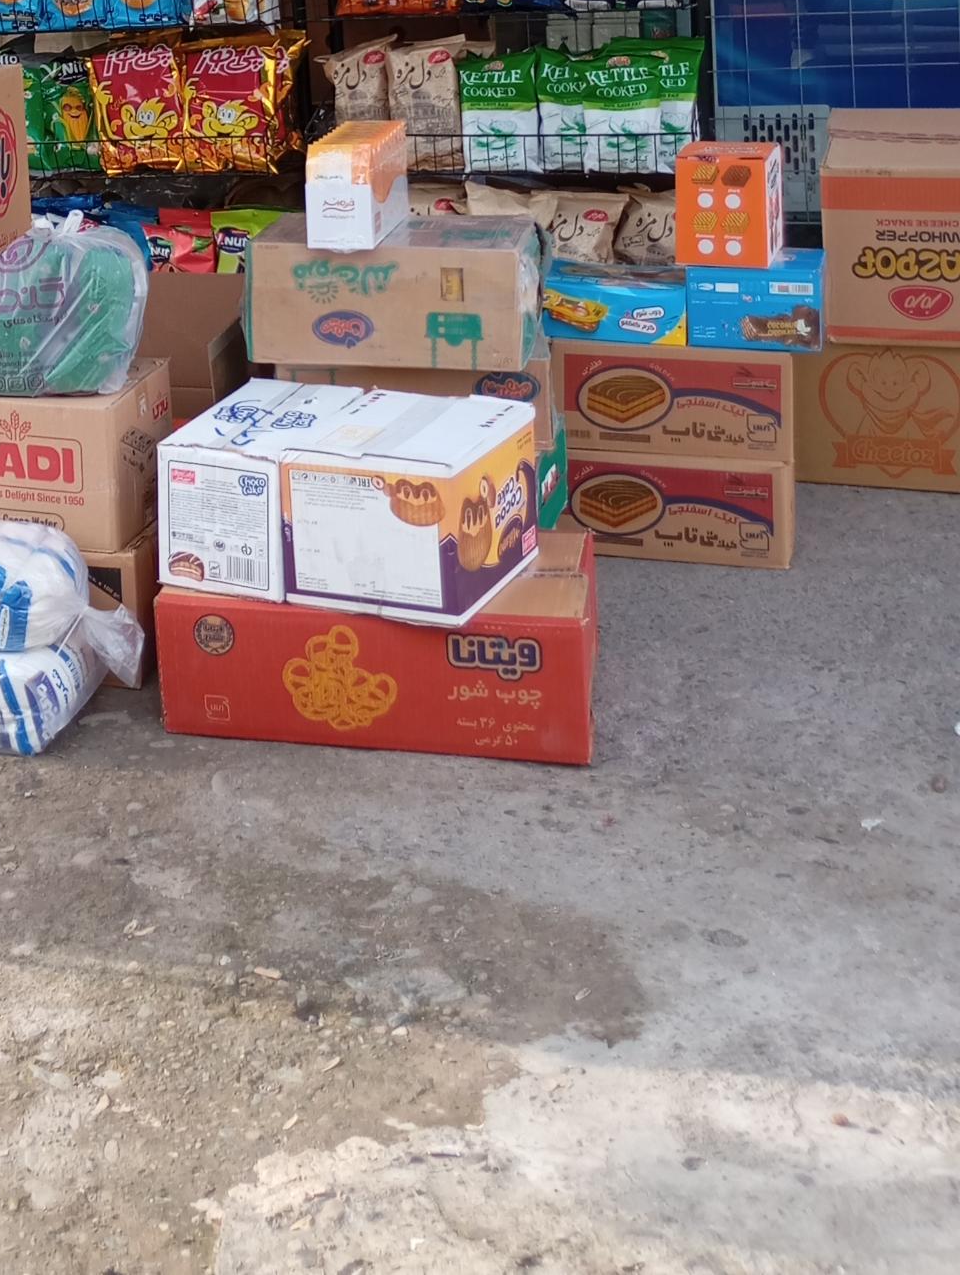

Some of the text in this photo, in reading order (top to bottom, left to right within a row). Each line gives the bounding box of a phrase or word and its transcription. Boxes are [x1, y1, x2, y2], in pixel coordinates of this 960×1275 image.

[459, 69, 523, 85] KETTLE
[585, 67, 652, 85] KETTLE
[463, 86, 516, 99] COOKED
[597, 83, 647, 98] COOKED
[875, 218, 959, 228] CHEESE SNACK
[676, 396, 721, 412] اسفنجی
[852, 438, 935, 464] Cheetoz
[5, 490, 35, 503] Delight
[37, 493, 61, 504] Since
[63, 495, 85, 506] 1950
[495, 485, 523, 530] Cocoa
[668, 503, 713, 519] اسفنجی
[447, 634, 541, 679] ویتانا
[448, 680, 542, 709] چوب شور
[456, 717, 477, 728] بسته
